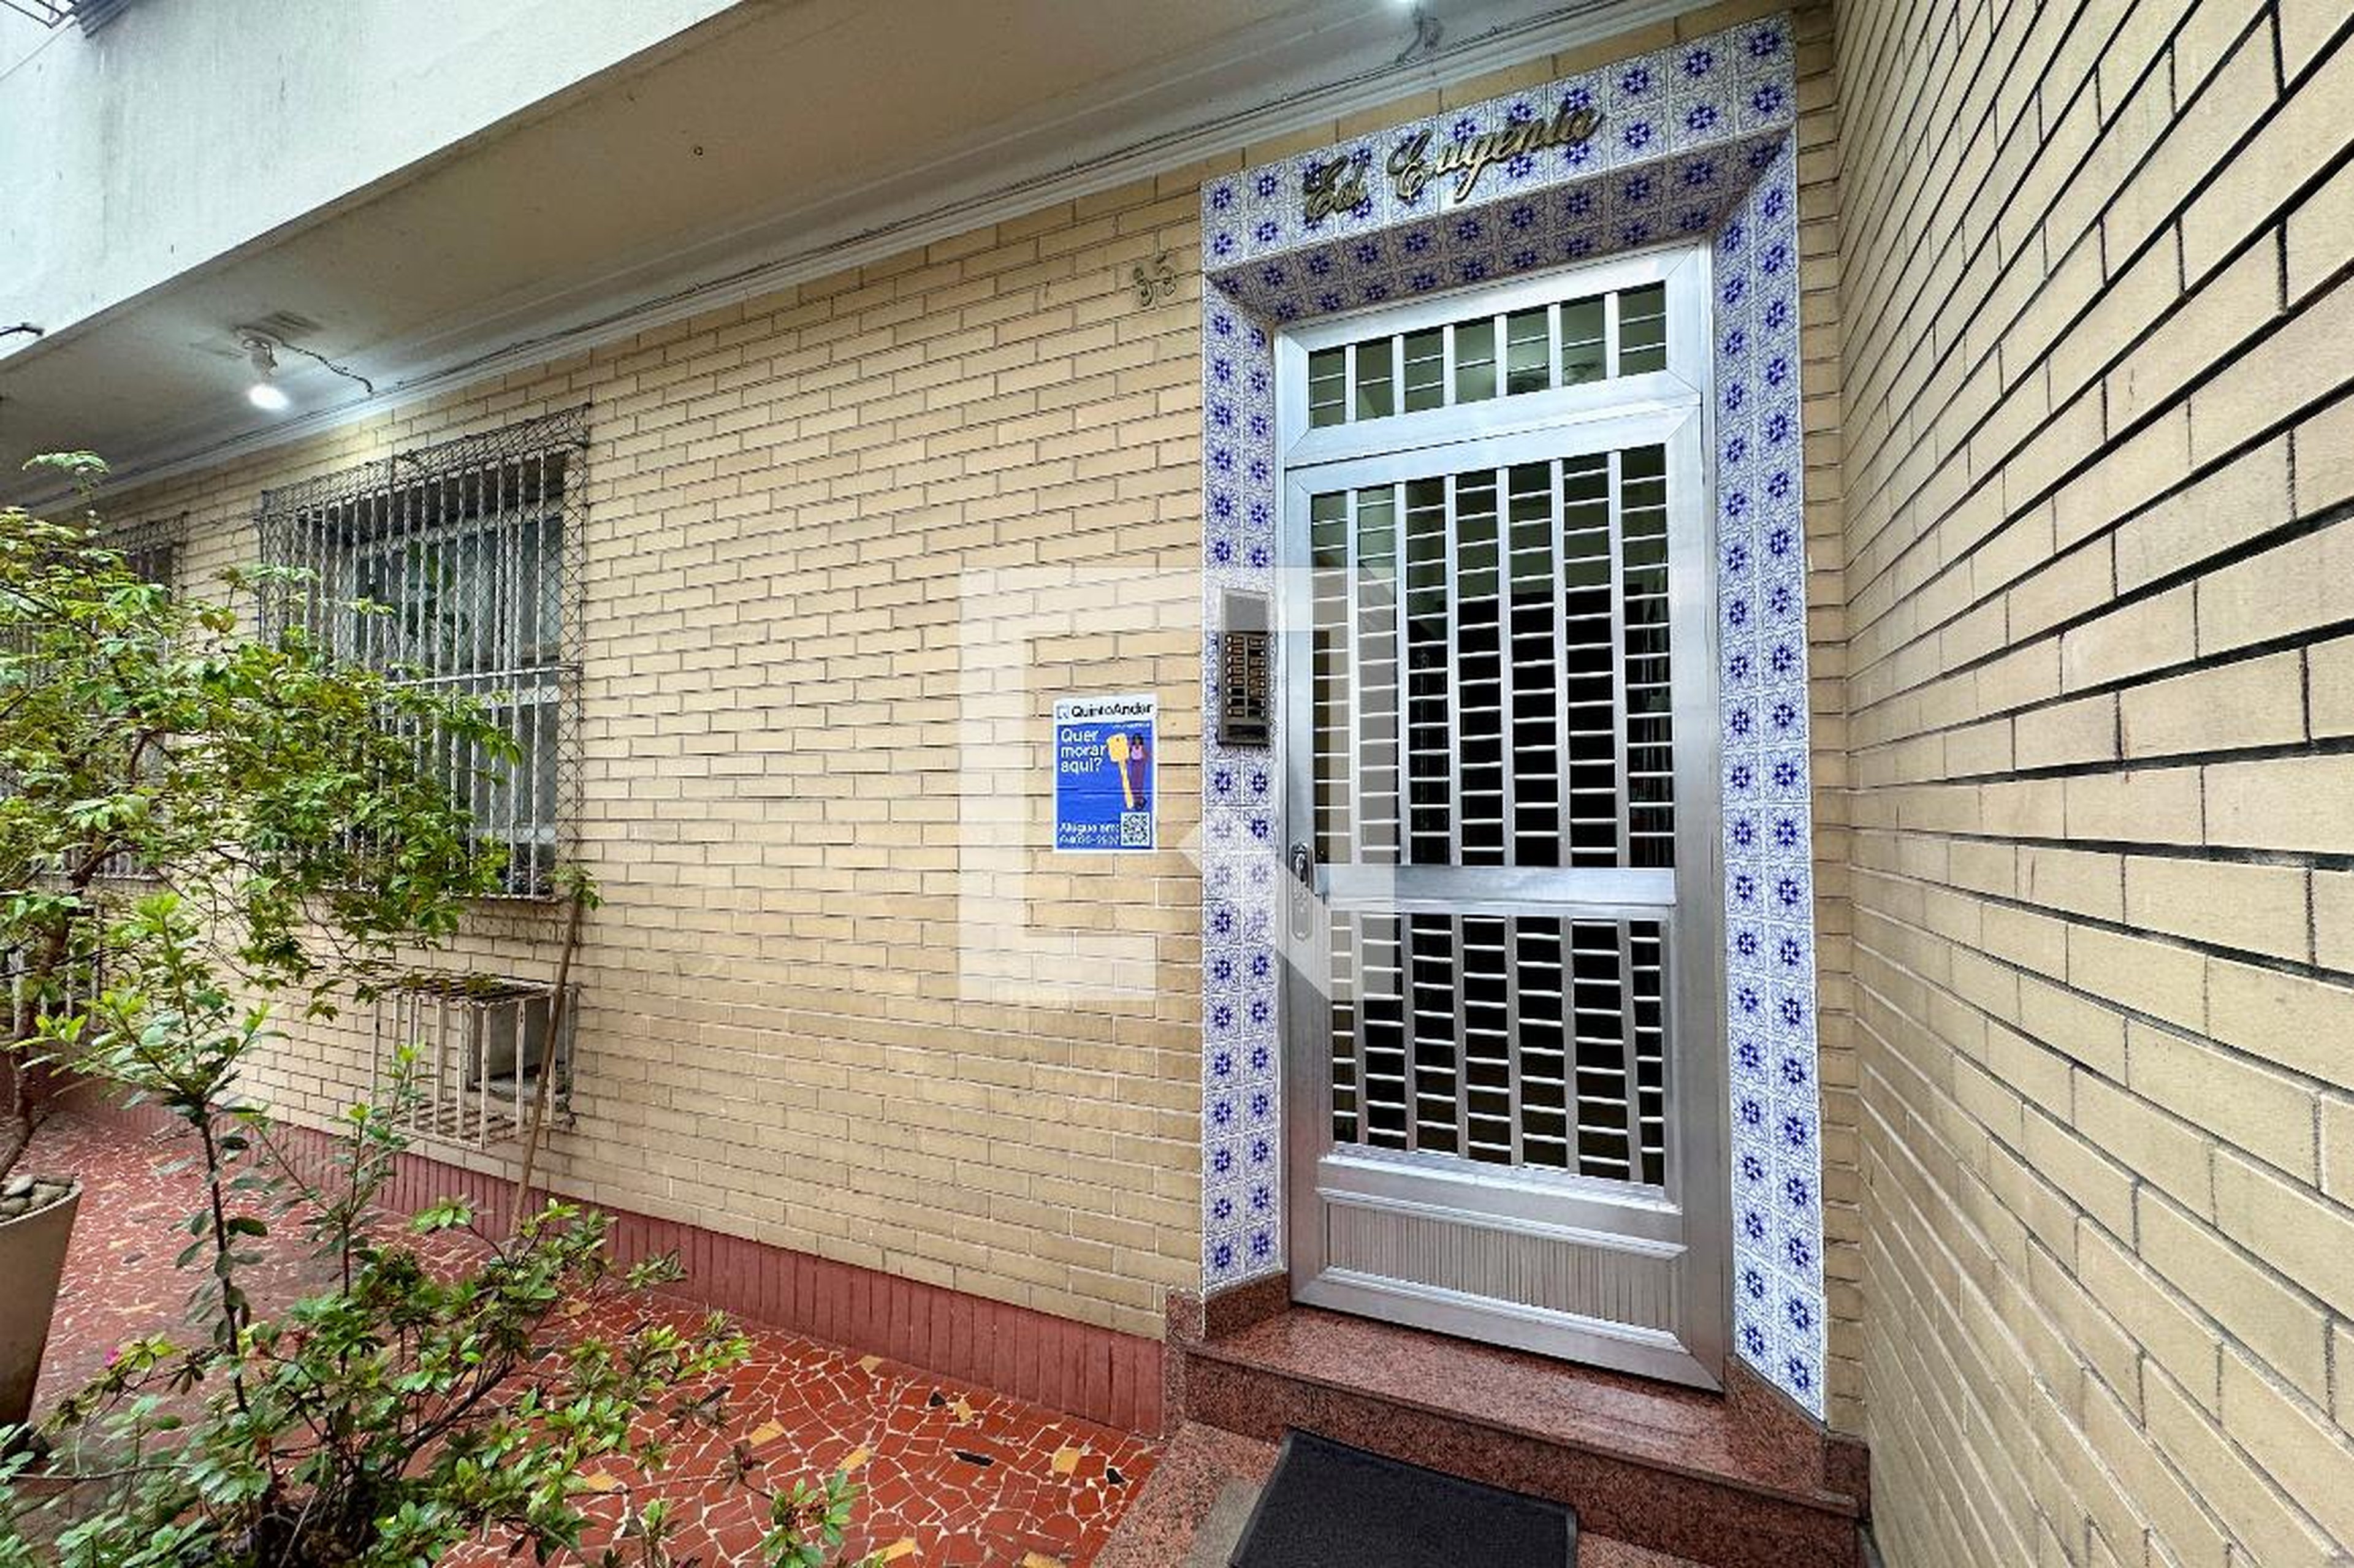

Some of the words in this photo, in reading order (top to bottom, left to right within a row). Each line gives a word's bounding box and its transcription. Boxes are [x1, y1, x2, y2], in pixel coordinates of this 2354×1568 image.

[1061, 728, 1099, 742] Quer
[1061, 744, 1106, 758] morar
[1061, 758, 1102, 774] aqui?
